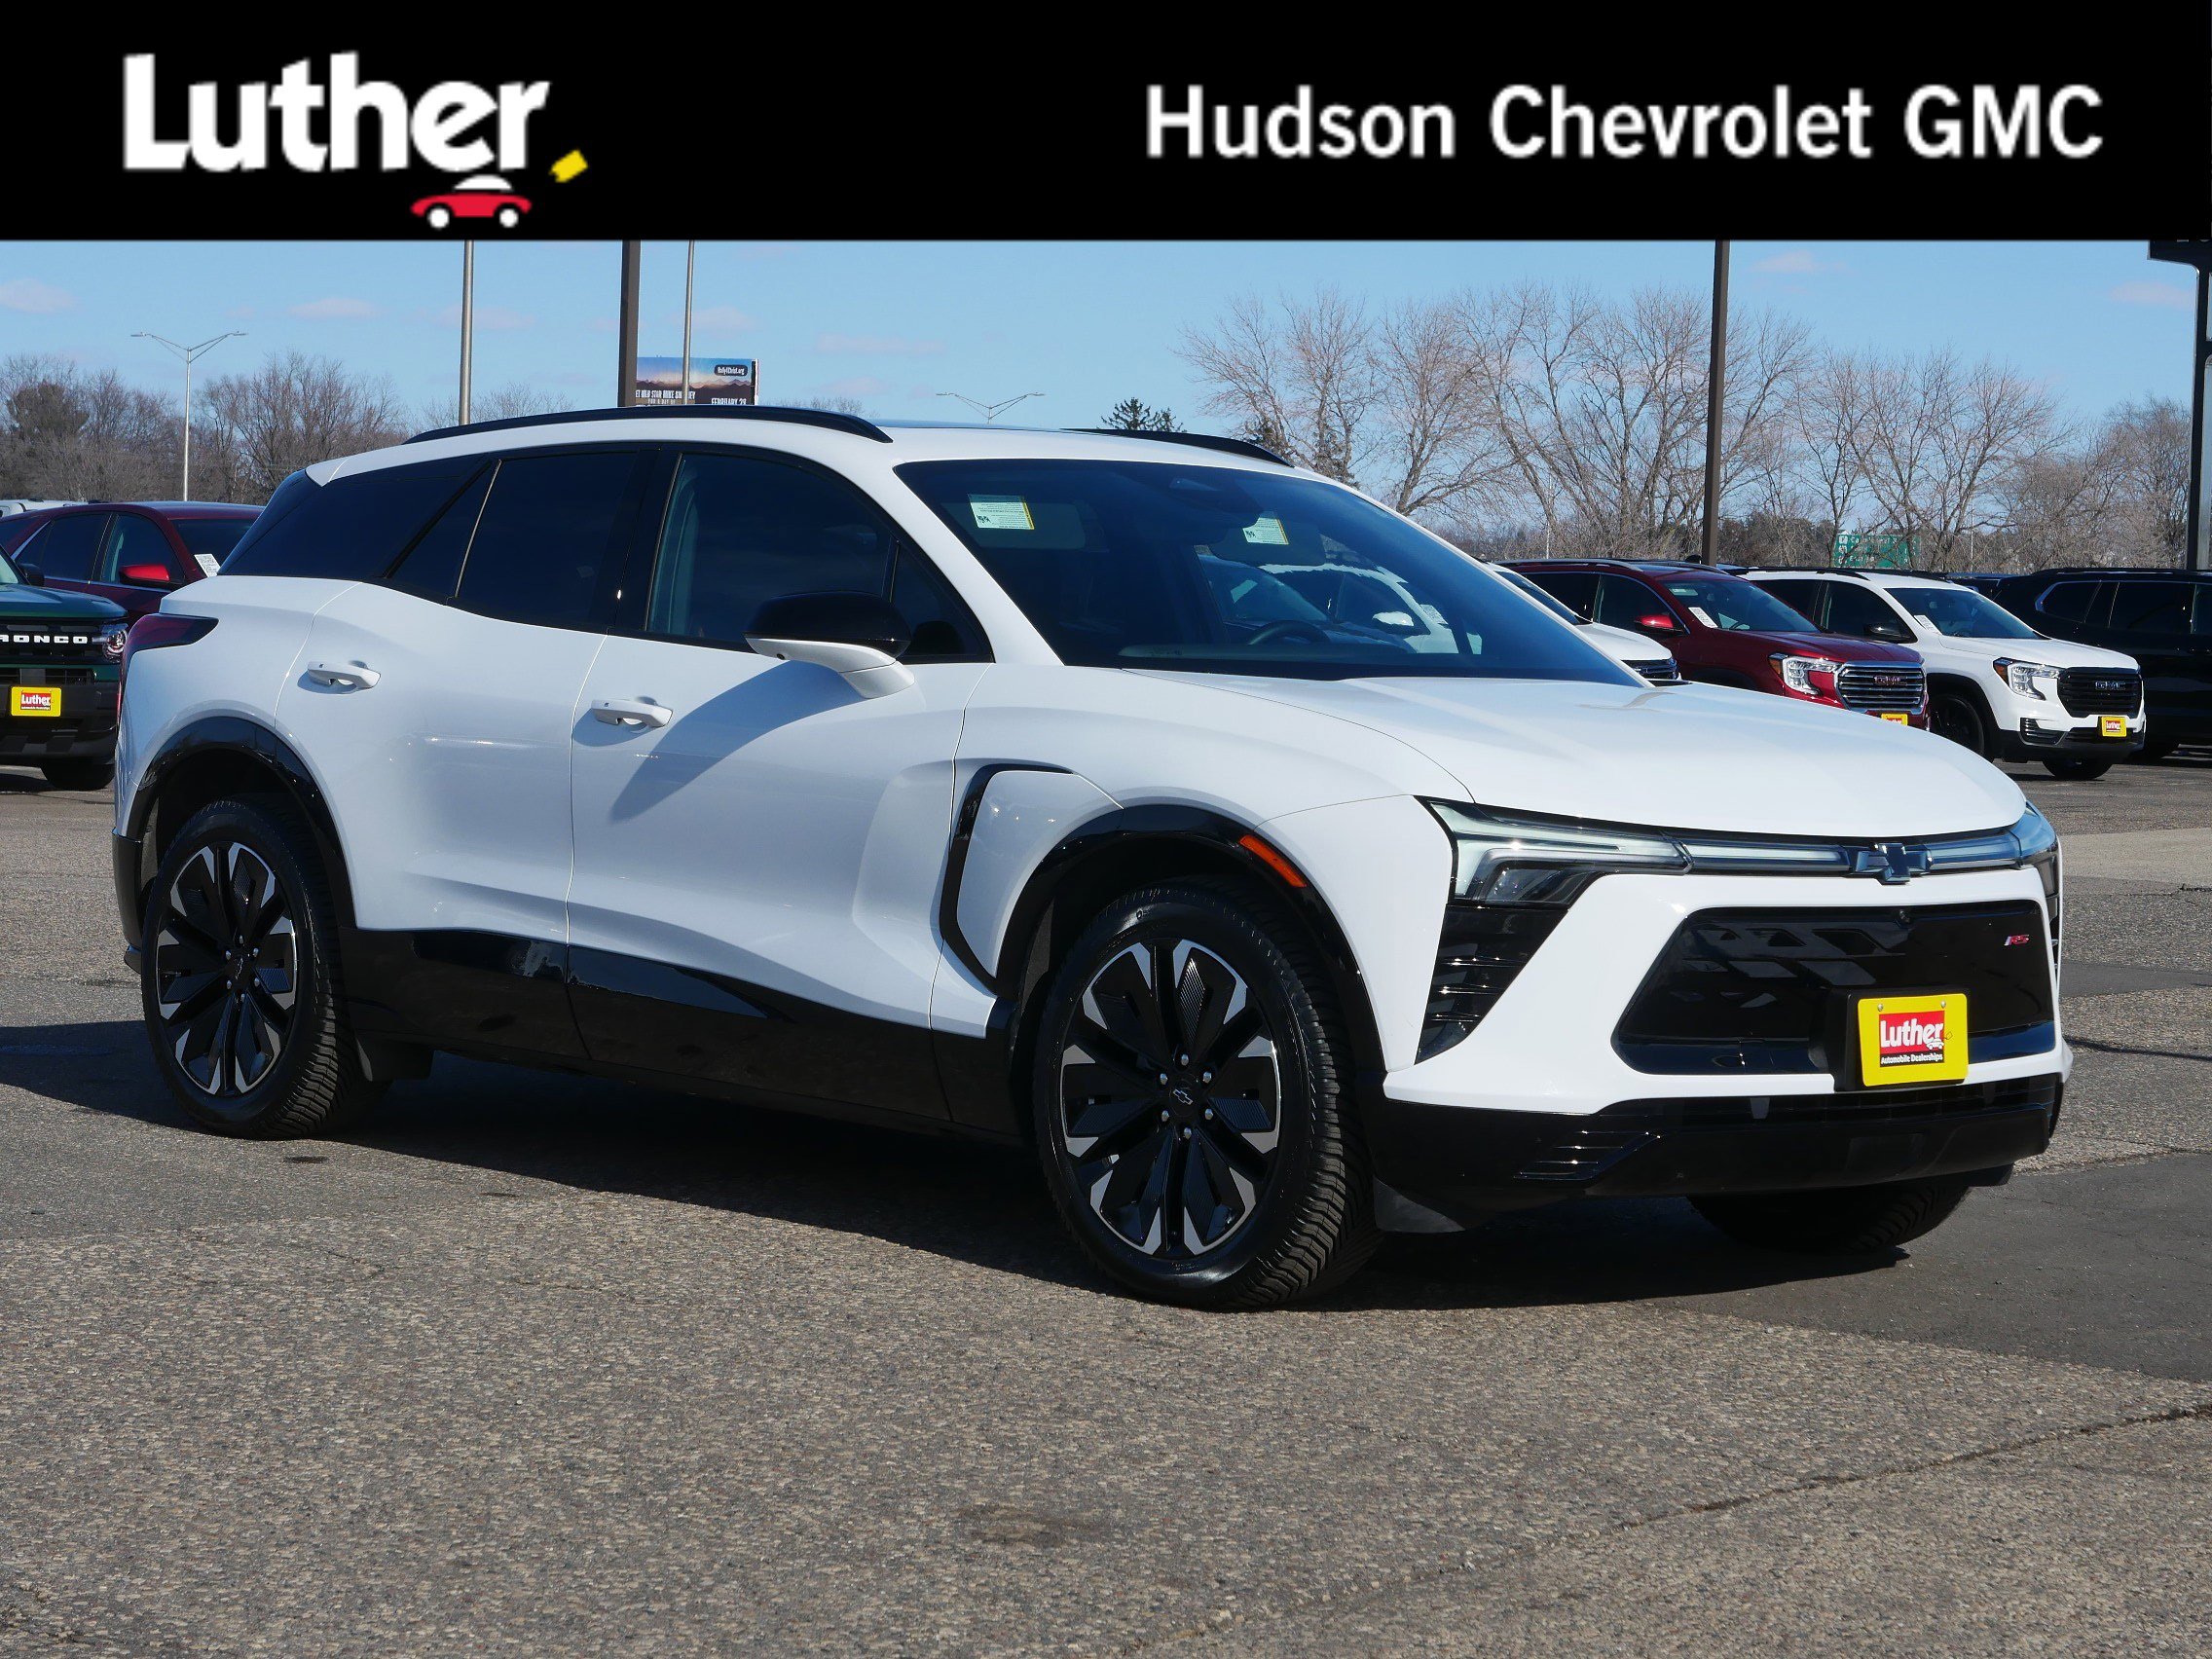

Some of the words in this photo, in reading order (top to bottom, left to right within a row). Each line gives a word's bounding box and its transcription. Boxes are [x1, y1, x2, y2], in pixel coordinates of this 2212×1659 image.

[2095, 681, 2126, 690] GMC
[21, 693, 52, 706] Luther
[1880, 1017, 1944, 1048] Luther
[1881, 1054, 1911, 1064] Automobile
[1910, 1052, 1943, 1062] Dealerships
